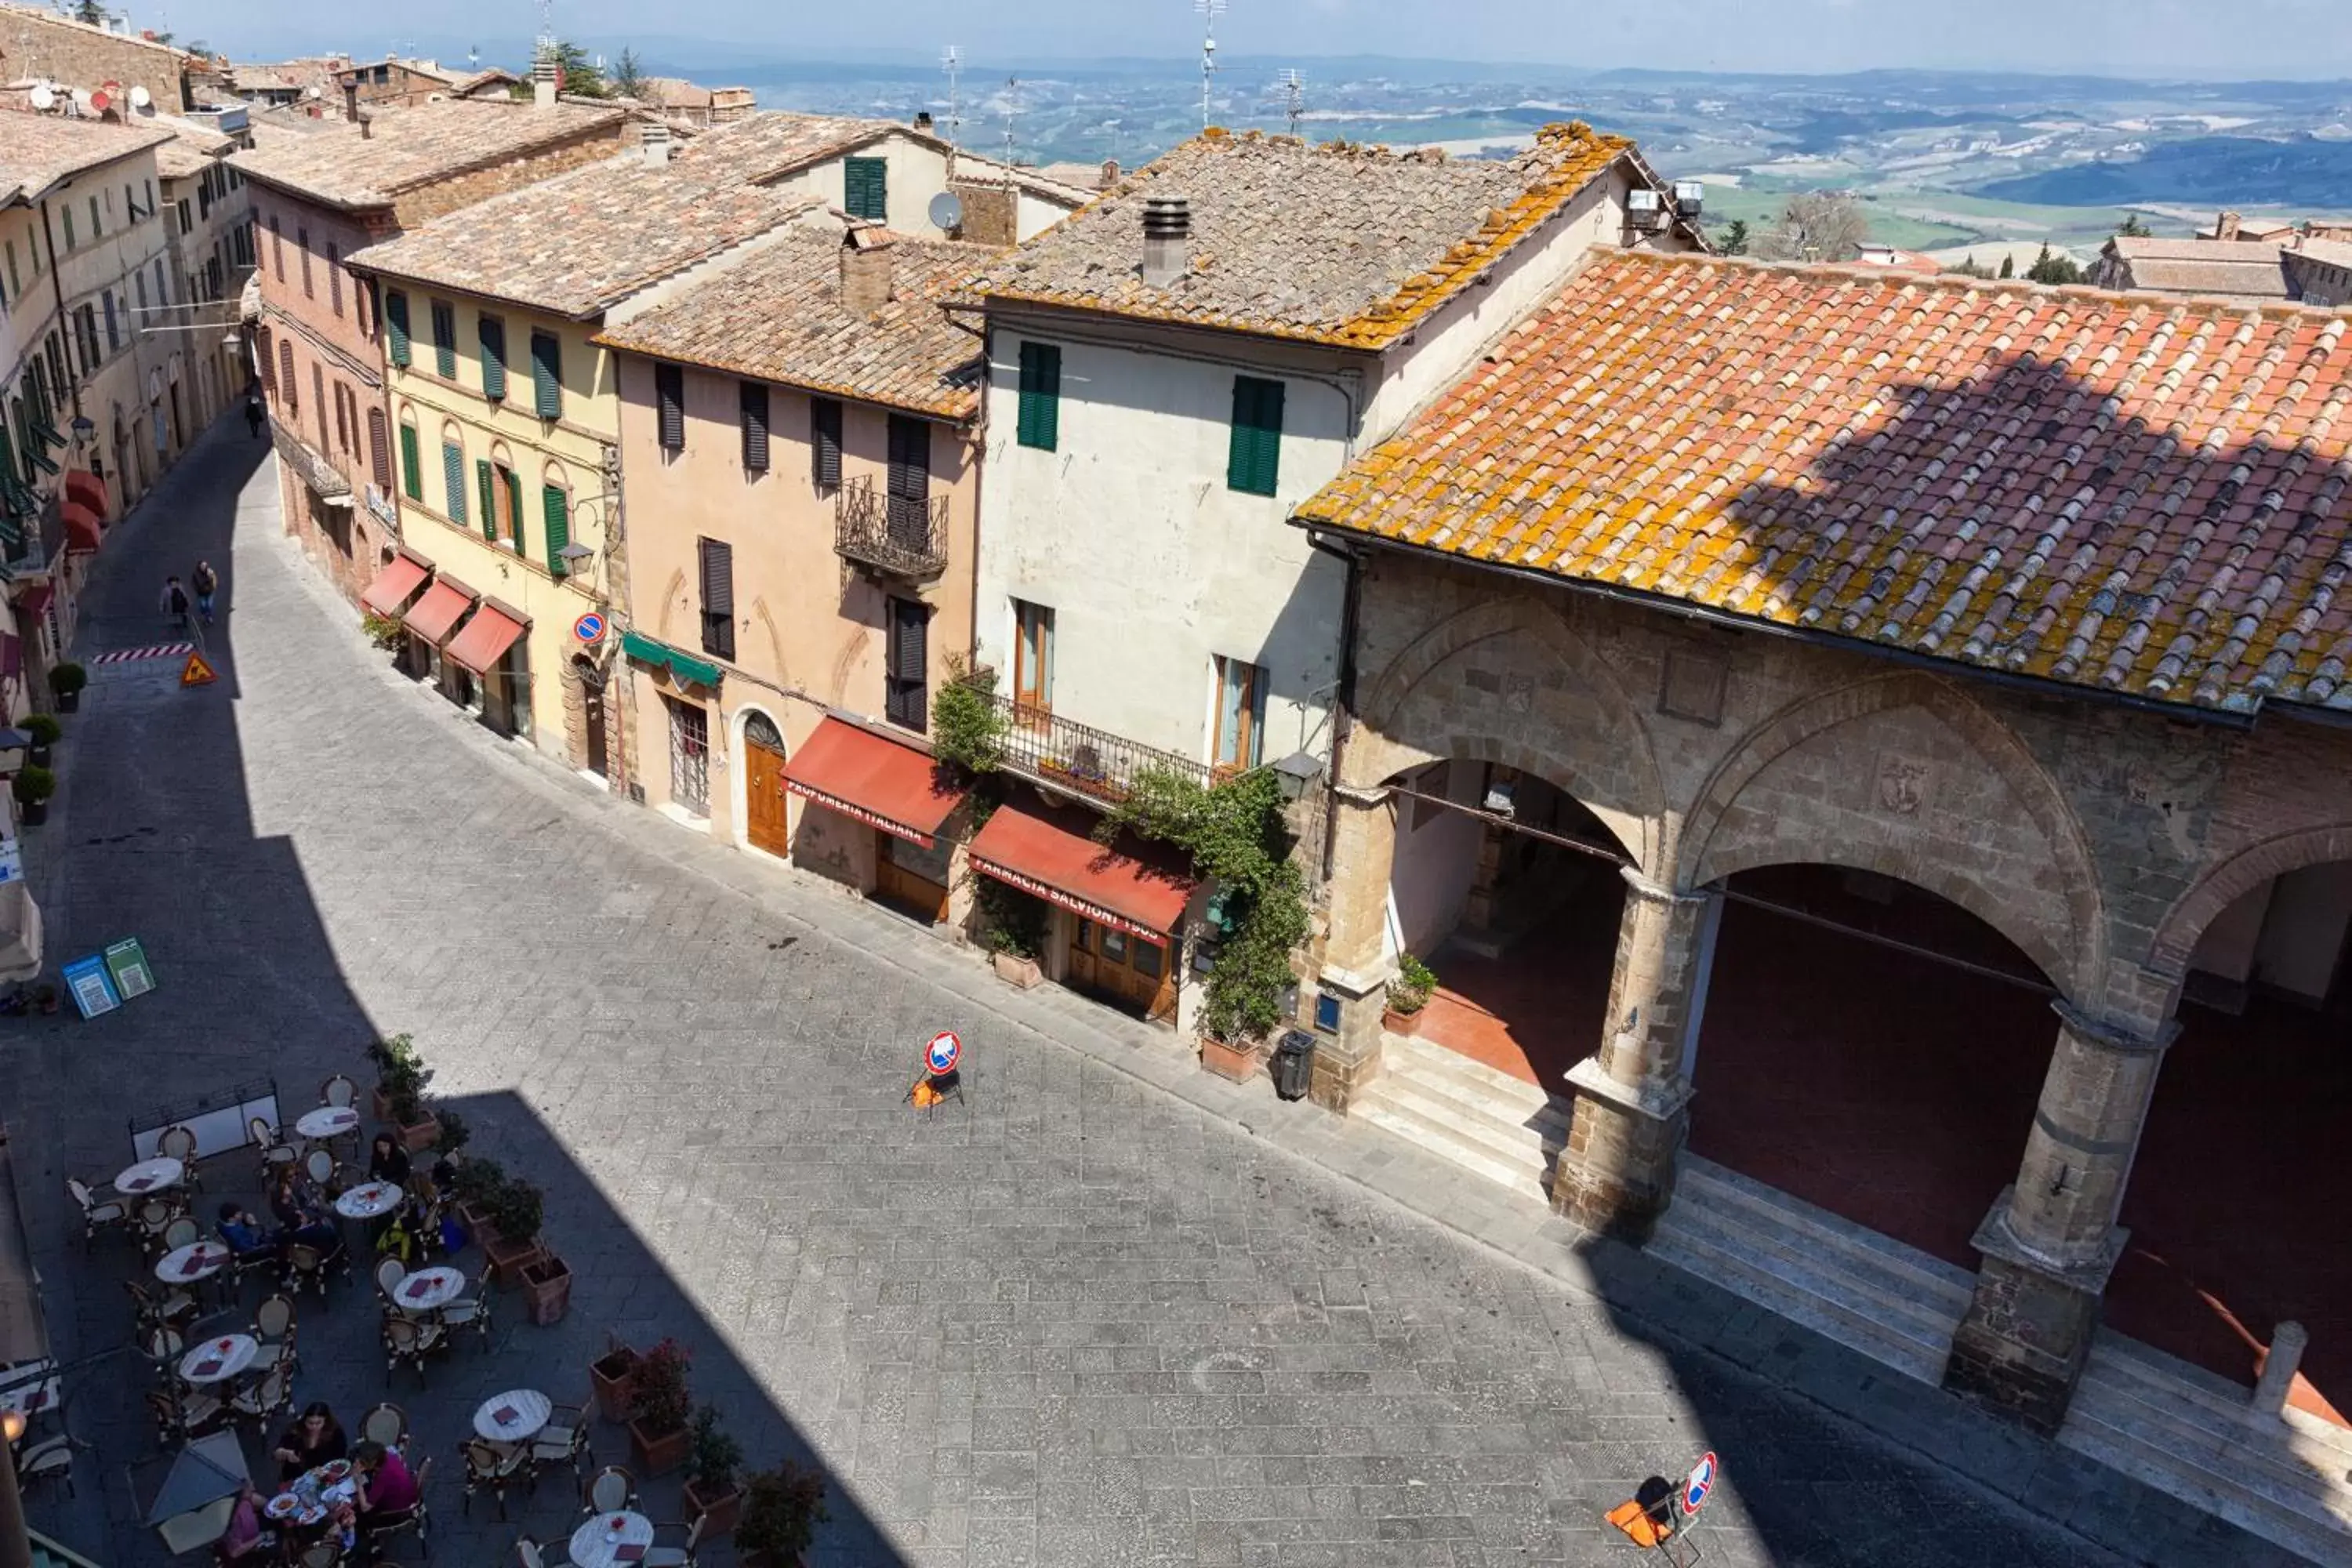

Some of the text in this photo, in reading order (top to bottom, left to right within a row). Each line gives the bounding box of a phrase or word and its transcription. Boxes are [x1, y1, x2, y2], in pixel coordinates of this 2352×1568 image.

[787, 780, 922, 841] PROFUMERIA ITALIANA
[975, 858, 1047, 895] FARMACIA
[1050, 889, 1118, 925] SALVIONI
